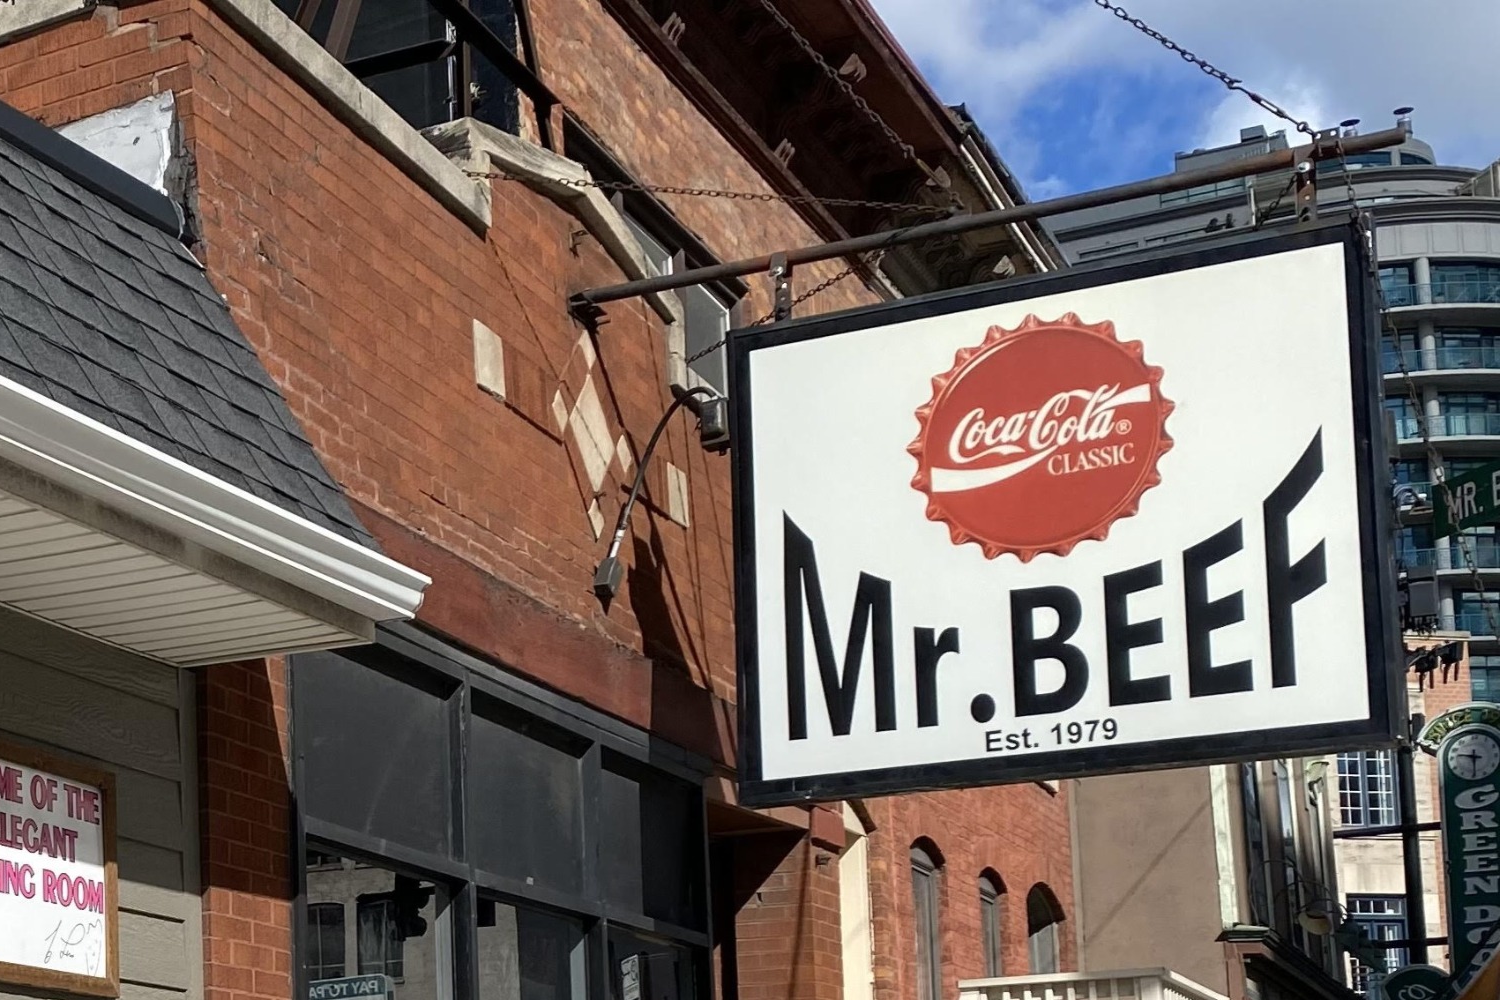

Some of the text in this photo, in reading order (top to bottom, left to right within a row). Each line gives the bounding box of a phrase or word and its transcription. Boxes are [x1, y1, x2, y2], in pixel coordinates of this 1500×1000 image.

[1048, 442, 1135, 475] CLASSIC
[1448, 481, 1484, 524] MR.
[783, 425, 1327, 741] Mr. BEEF
[985, 717, 1119, 753] Est. 1979
[30, 774, 59, 812] OF
[63, 783, 101, 826] THE
[1455, 783, 1500, 896] GREEN
[42, 868, 105, 914] ROOM
